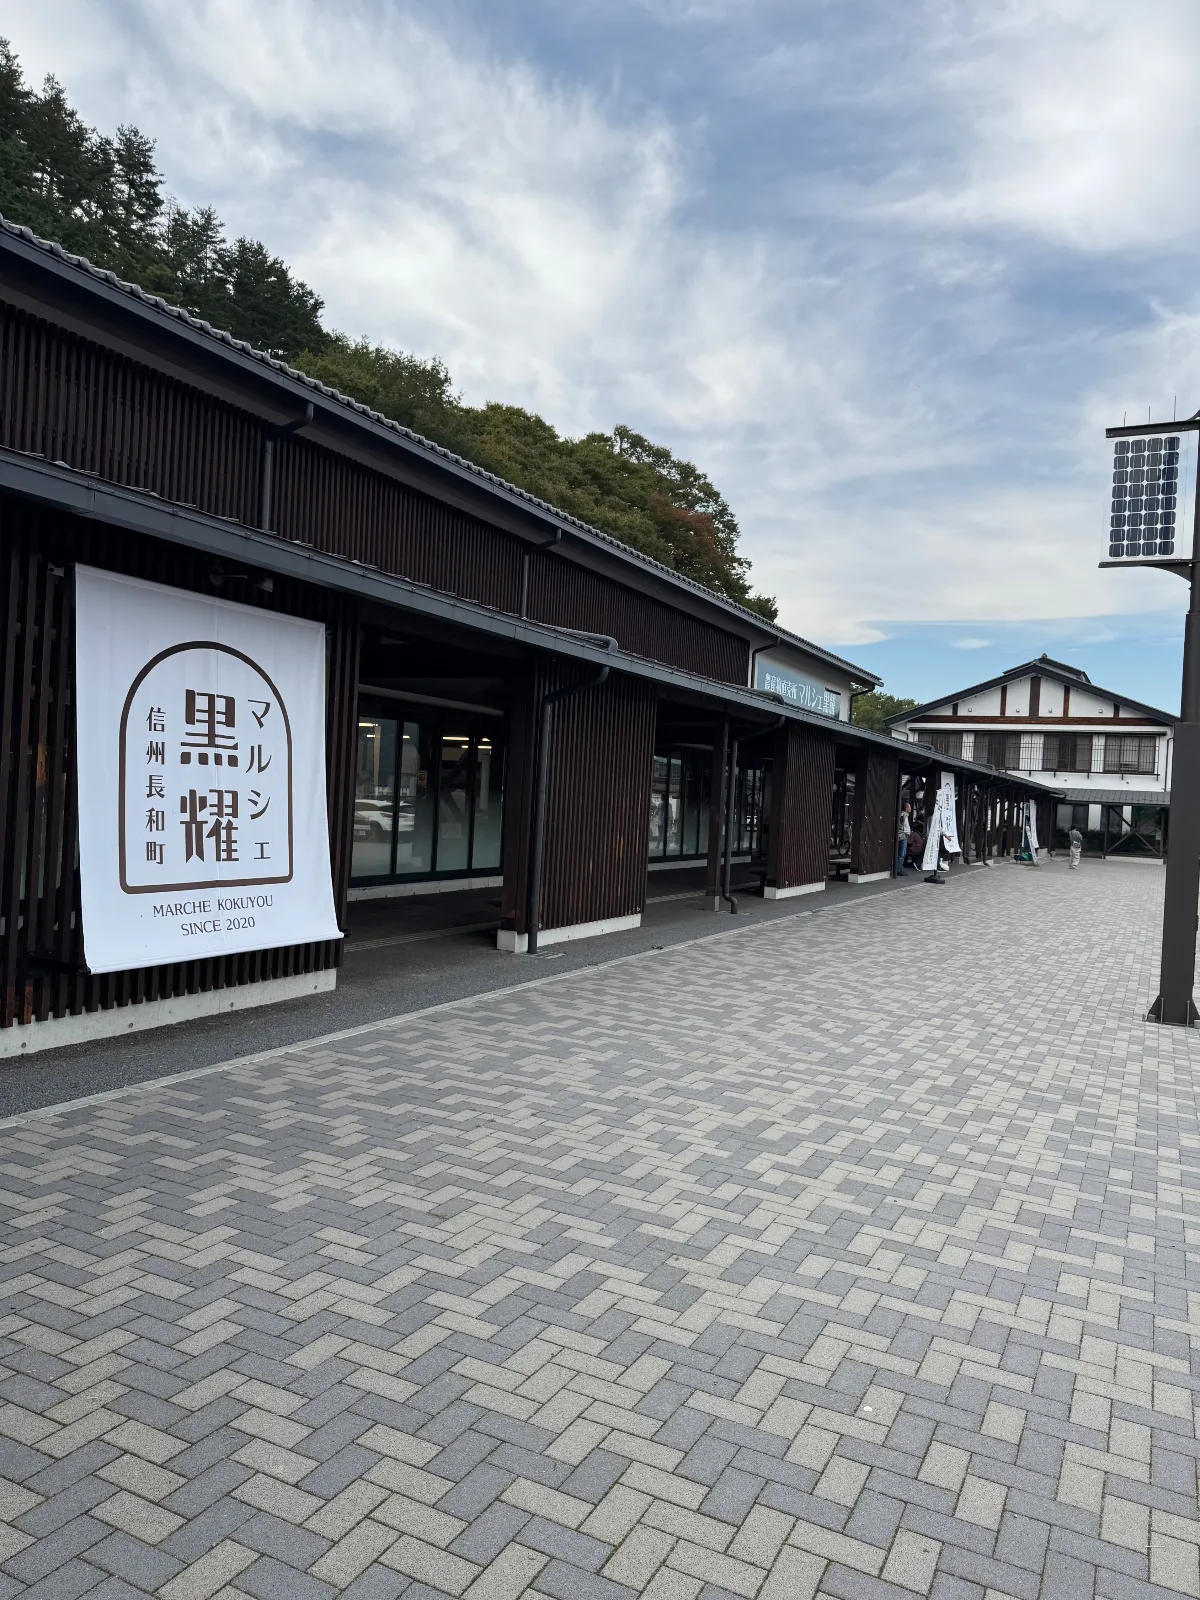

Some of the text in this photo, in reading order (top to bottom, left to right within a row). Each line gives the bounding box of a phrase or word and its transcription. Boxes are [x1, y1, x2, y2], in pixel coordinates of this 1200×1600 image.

[145, 706, 166, 865] 信州長和町
[179, 688, 240, 863] 黒耀
[245, 699, 272, 860] マルシェ
[152, 894, 274, 918] MARCHE KOKUYOU
[180, 916, 256, 937] SINCE 2020
